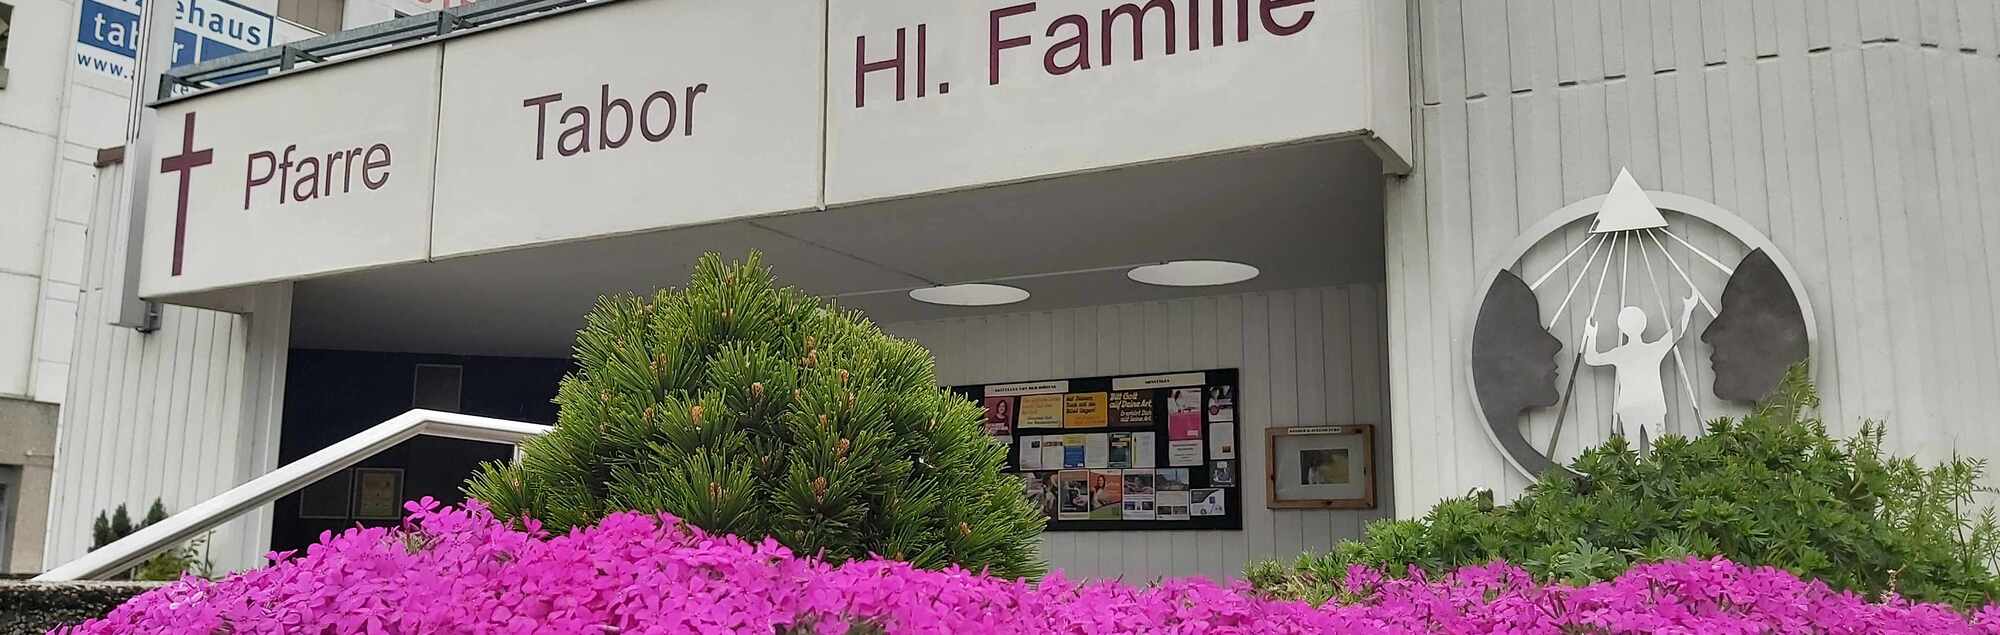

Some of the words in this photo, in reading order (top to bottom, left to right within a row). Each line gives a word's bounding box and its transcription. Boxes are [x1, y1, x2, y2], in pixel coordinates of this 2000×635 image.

[244, 141, 391, 210] Pfarre
[523, 82, 708, 160] Tabor
[989, 0, 1316, 85] Familie
